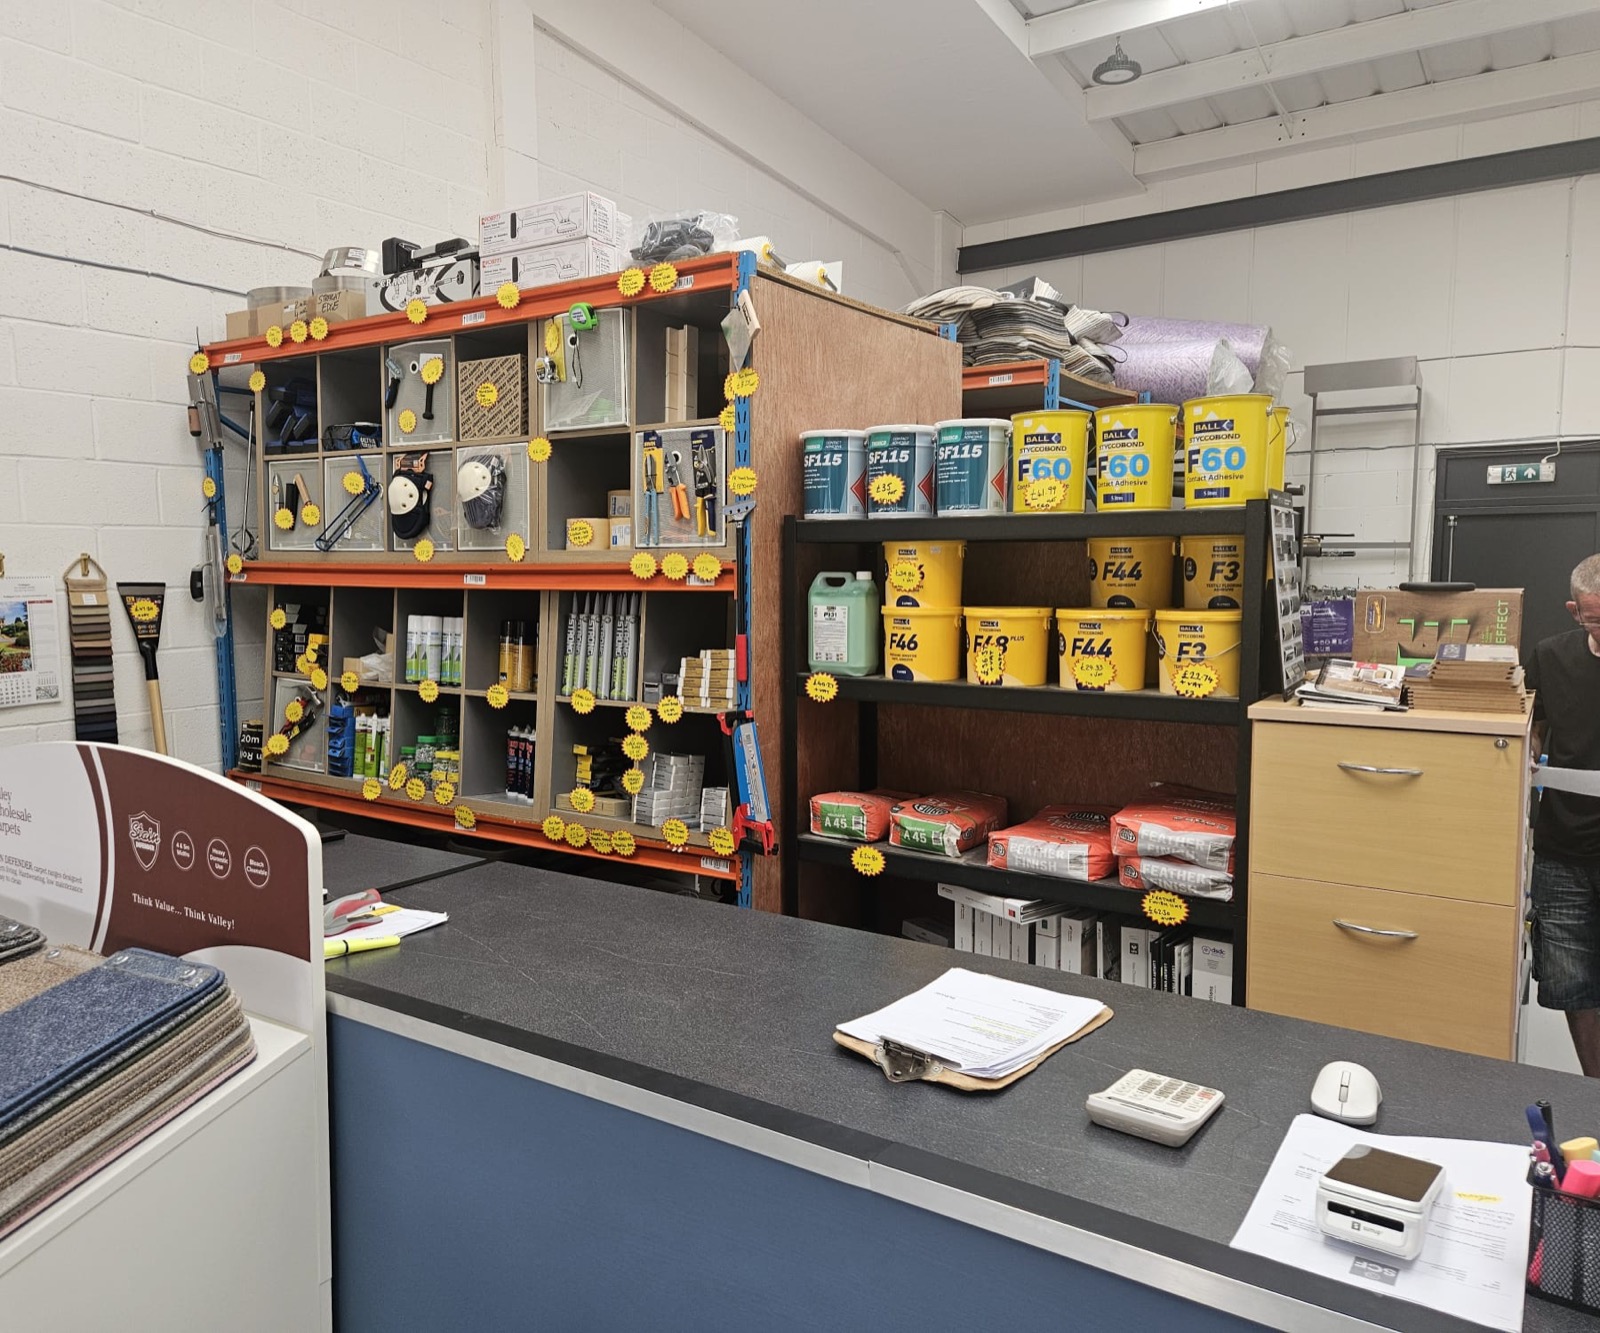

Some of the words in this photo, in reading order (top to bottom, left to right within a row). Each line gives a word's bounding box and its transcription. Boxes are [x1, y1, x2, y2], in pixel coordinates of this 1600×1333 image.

[321, 301, 339, 314] EDGE
[1196, 424, 1220, 432] BALL
[1026, 435, 1050, 443] BALL
[1104, 432, 1125, 440] BALL
[1190, 434, 1240, 444] STYCCOBOND
[939, 445, 982, 460] SF115
[1020, 446, 1067, 454] STYCCOBOND
[1099, 442, 1144, 450] STYCCOBOND
[804, 453, 842, 468] SF115
[868, 450, 910, 464] SF115
[1188, 446, 1246, 473] F60
[1018, 458, 1072, 482] F60
[1098, 454, 1150, 480] F60
[1208, 473, 1244, 481] Adhesive
[1102, 561, 1143, 581] F44
[1210, 561, 1240, 582] F3
[1495, 600, 1509, 644] EFFECT
[889, 633, 918, 651] F46
[1071, 638, 1112, 658] F44
[1176, 642, 1207, 663] F3
[240, 734, 260, 744] 20m
[825, 816, 832, 827] A
[833, 816, 847, 828] 45
[129, 820, 161, 844] Stain
[904, 830, 910, 840] A
[912, 831, 927, 843] 45
[1141, 830, 1205, 851] FEATHER
[176, 849, 190, 858] Widths
[212, 848, 226, 858] Heavy
[1010, 842, 1066, 860] FEATHER
[5, 855, 32, 870] DEFENDER
[210, 854, 228, 864] Domestic
[250, 859, 264, 868] Bleach
[1014, 856, 1058, 872] FINISH
[246, 866, 268, 876] Cleanable
[1142, 860, 1206, 885] FEATHER
[132, 892, 153, 907] Think
[155, 899, 182, 915] Value...
[184, 906, 206, 922] Think
[208, 913, 235, 930] Valley!
[1354, 1261, 1397, 1277] SCF
